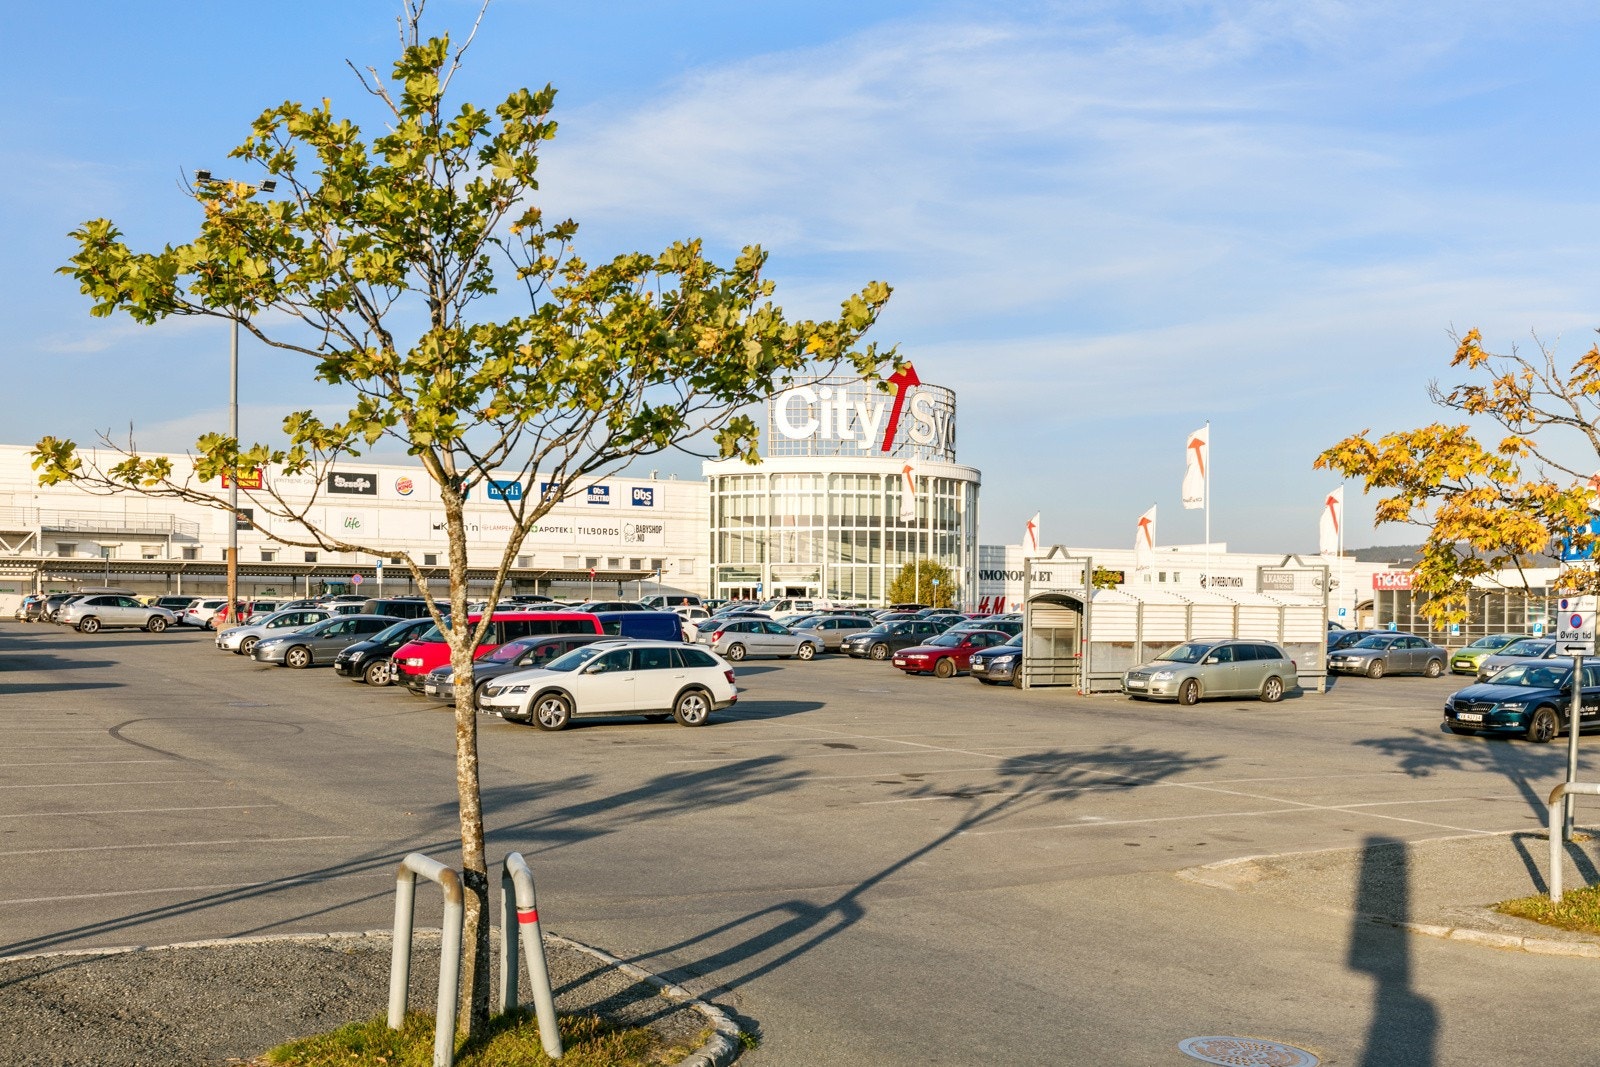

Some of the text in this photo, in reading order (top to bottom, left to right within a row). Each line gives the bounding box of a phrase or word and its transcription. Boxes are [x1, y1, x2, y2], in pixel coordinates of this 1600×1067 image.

[774, 387, 885, 450] City
[633, 489, 652, 500] Obs
[344, 516, 361, 529] life
[636, 525, 662, 534] BABYSHOP
[1376, 573, 1415, 586] TICKET
[978, 596, 1006, 614] H&M
[1560, 631, 1592, 640] Øvrig tid
